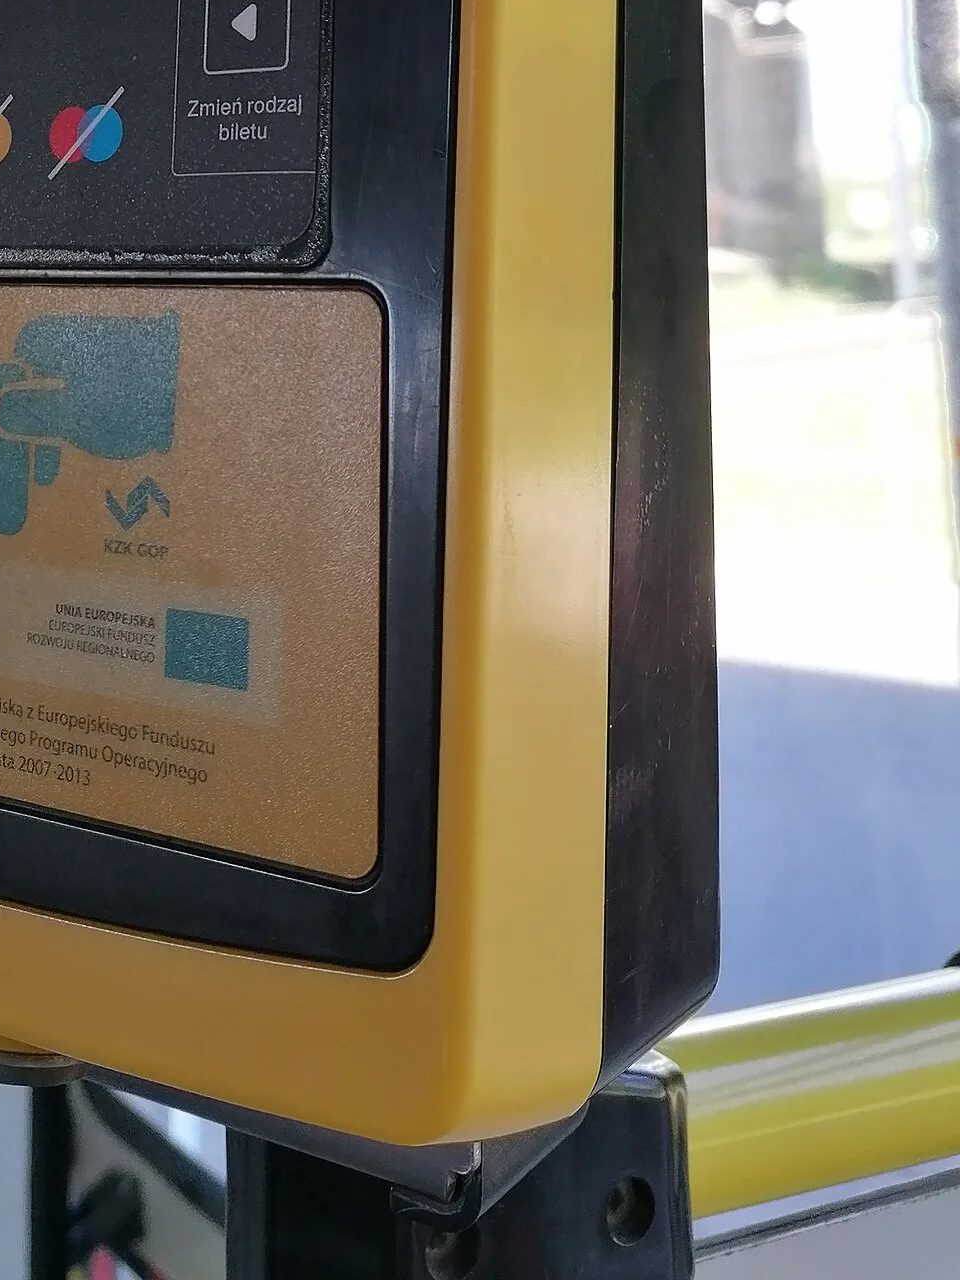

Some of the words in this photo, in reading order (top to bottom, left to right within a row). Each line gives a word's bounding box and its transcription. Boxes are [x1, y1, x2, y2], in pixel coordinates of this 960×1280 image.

[187, 95, 242, 118] Zmień
[247, 94, 303, 117] rodzaj
[218, 122, 268, 141] biletu
[104, 538, 132, 554] KZK
[137, 542, 168, 559] GOP
[48, 619, 106, 639] EUROPEJSKI
[55, 603, 83, 620] UNIA
[85, 608, 156, 629] EUROPEJSKA
[27, 632, 75, 652] ROZWOJU
[76, 640, 156, 664] REGIONALNEGO
[38, 705, 138, 743] Europejskiego
[142, 724, 216, 756] Funduszu
[19, 756, 91, 786] 2007-2013
[30, 732, 98, 759] Programu
[102, 746, 208, 784] Operacyjnego
